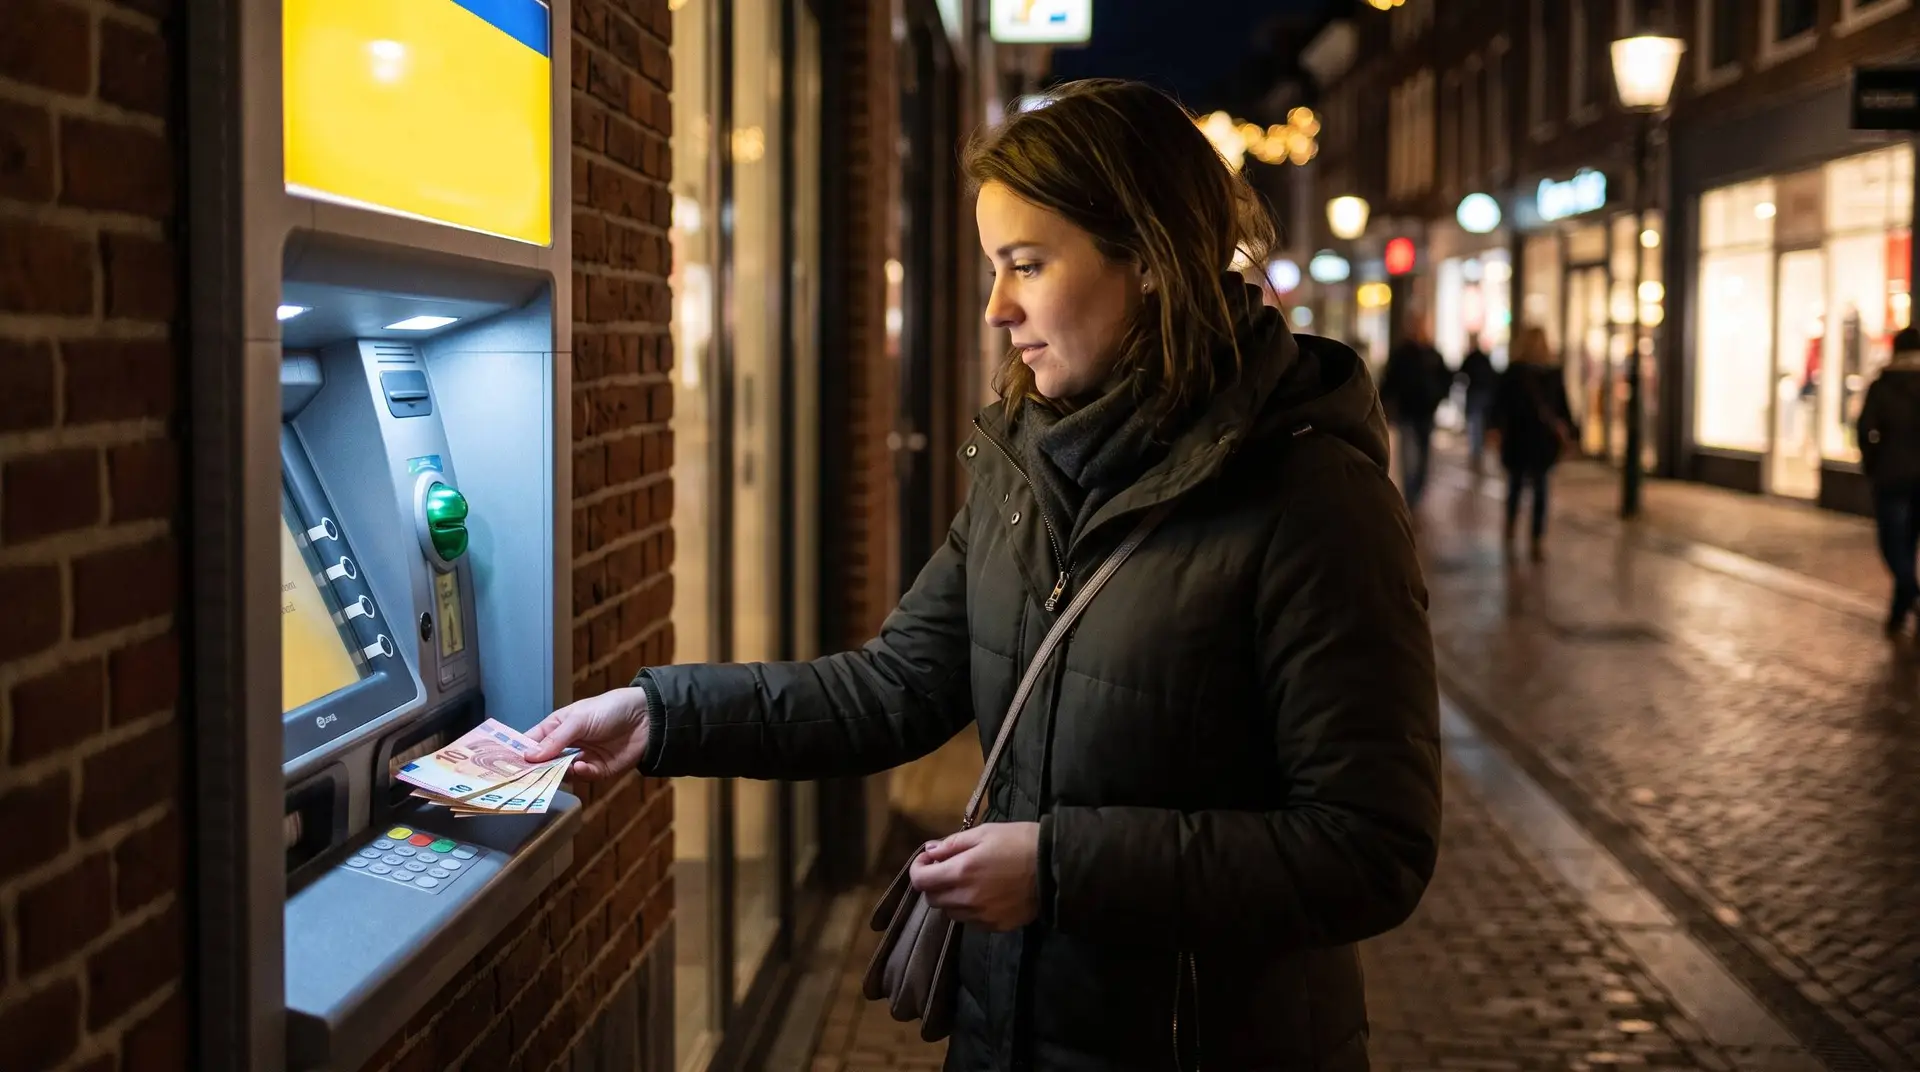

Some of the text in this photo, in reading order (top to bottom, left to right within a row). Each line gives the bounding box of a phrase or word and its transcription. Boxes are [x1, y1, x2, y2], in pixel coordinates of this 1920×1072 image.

[436, 751, 468, 764] 10
[450, 784, 473, 793] 10
[481, 794, 503, 802] 10
